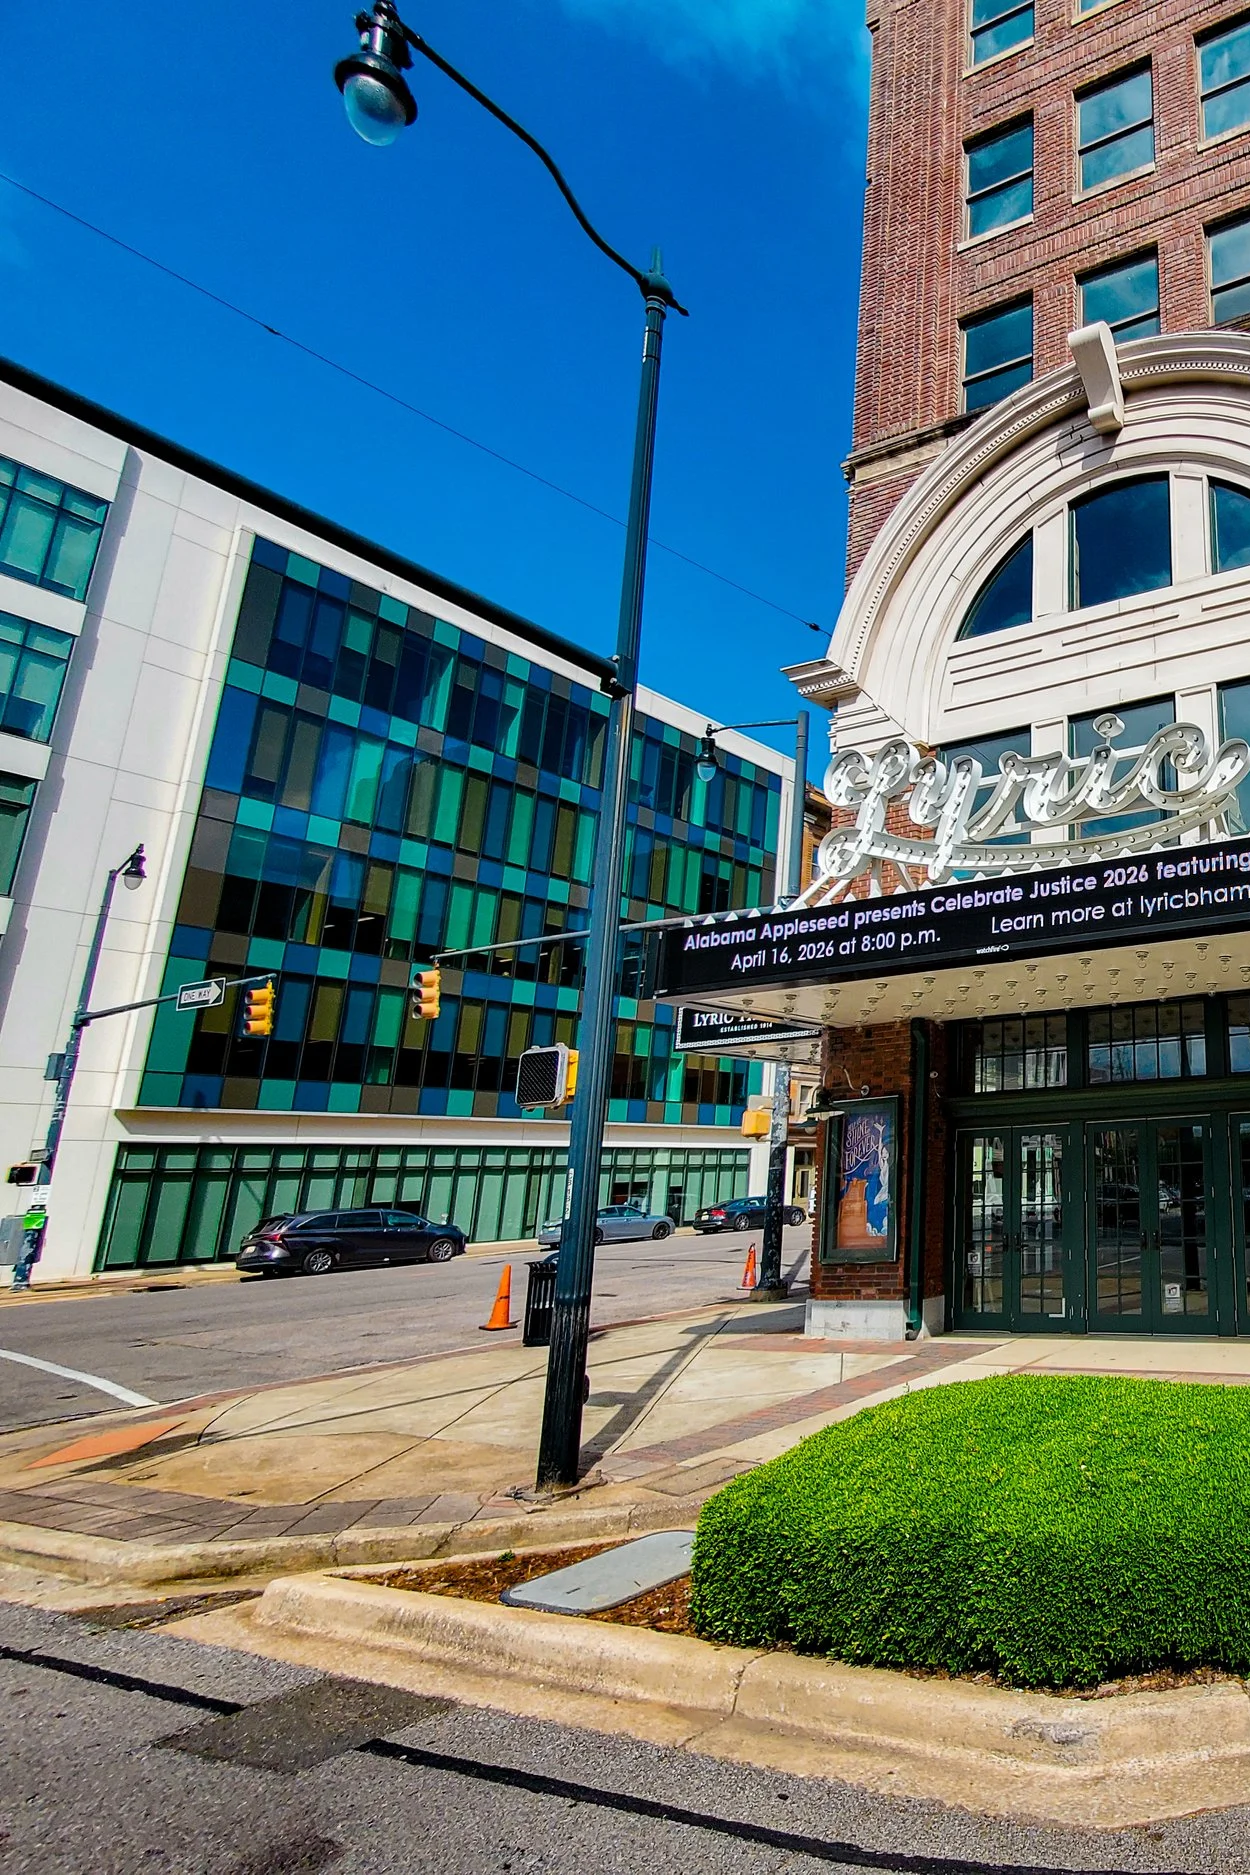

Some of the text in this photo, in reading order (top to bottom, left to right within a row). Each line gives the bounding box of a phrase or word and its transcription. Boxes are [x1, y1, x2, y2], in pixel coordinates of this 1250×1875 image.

[684, 928, 757, 951] Alabama
[760, 910, 849, 942] Appleseed
[854, 901, 926, 930] presents
[931, 885, 1023, 914] Celebrate
[1029, 875, 1097, 899] Justice
[1103, 864, 1149, 888] 2026
[991, 913, 1044, 934] Learn
[1051, 905, 1105, 926] more
[1111, 897, 1133, 918] at
[730, 929, 941, 973] April 16, 2026 at 8:00 p.m.
[720, 1022, 758, 1033] ESTABLISHED
[845, 1134, 876, 1170] FOREVER
